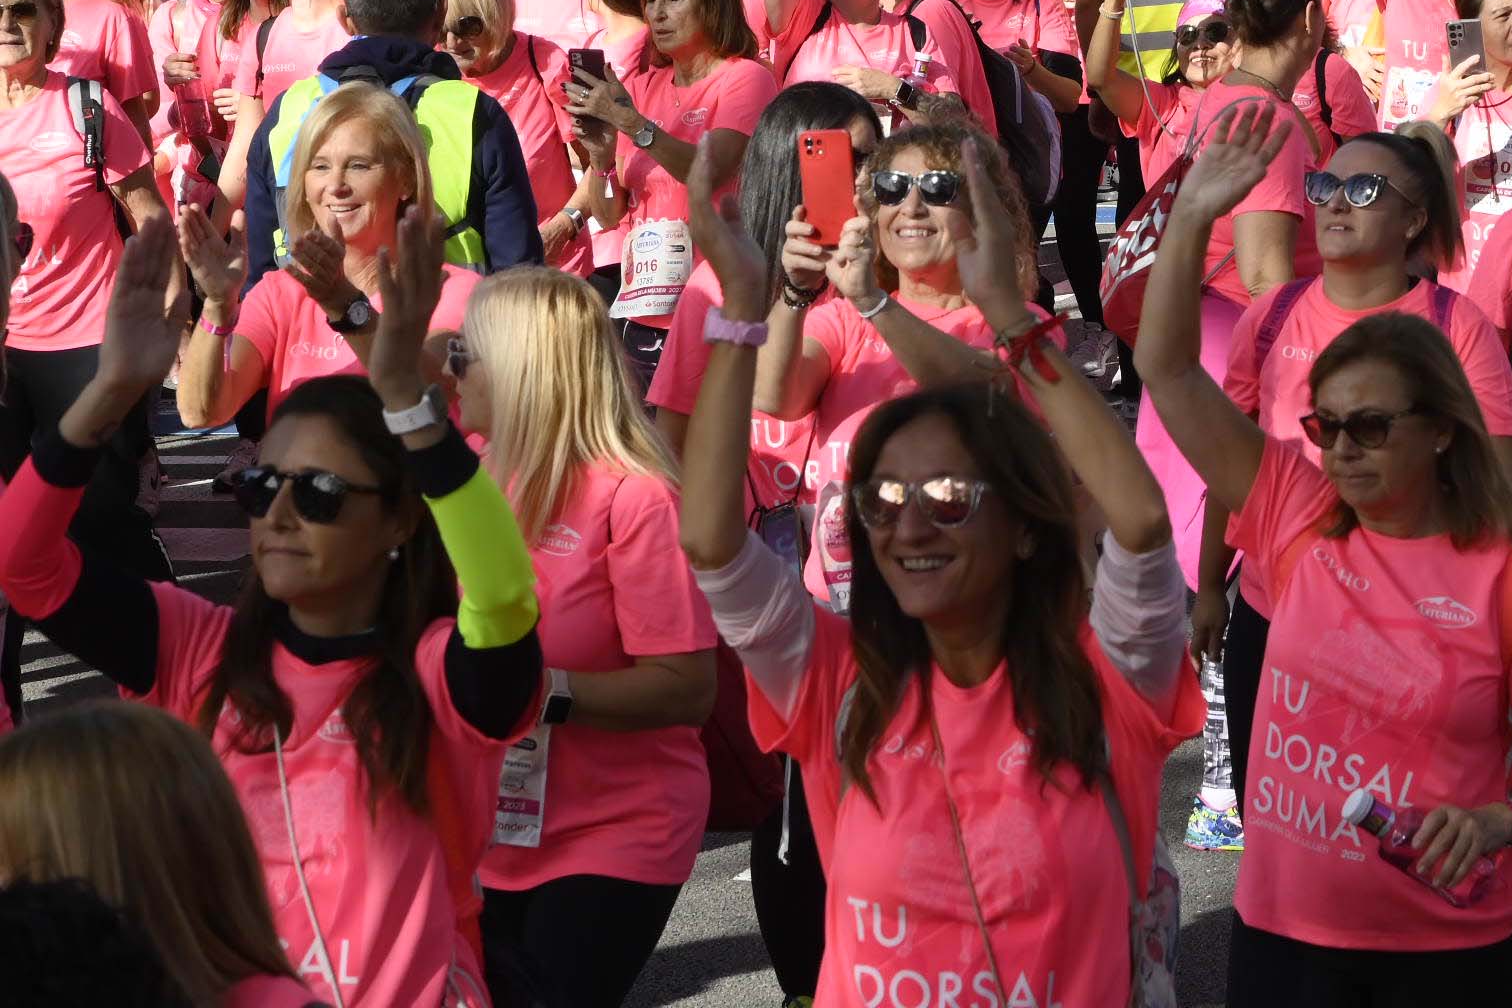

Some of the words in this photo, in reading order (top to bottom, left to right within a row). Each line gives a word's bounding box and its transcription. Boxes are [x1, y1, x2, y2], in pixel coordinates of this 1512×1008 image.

[1402, 39, 1428, 61] TU
[635, 259, 658, 274] 016
[1419, 602, 1471, 623] ASTURIANA
[1270, 667, 1310, 715] TU
[1264, 721, 1415, 809] DORSAL
[1252, 775, 1362, 848] SUMA
[847, 896, 907, 948] TU
[854, 964, 1064, 1008] DORSAL
